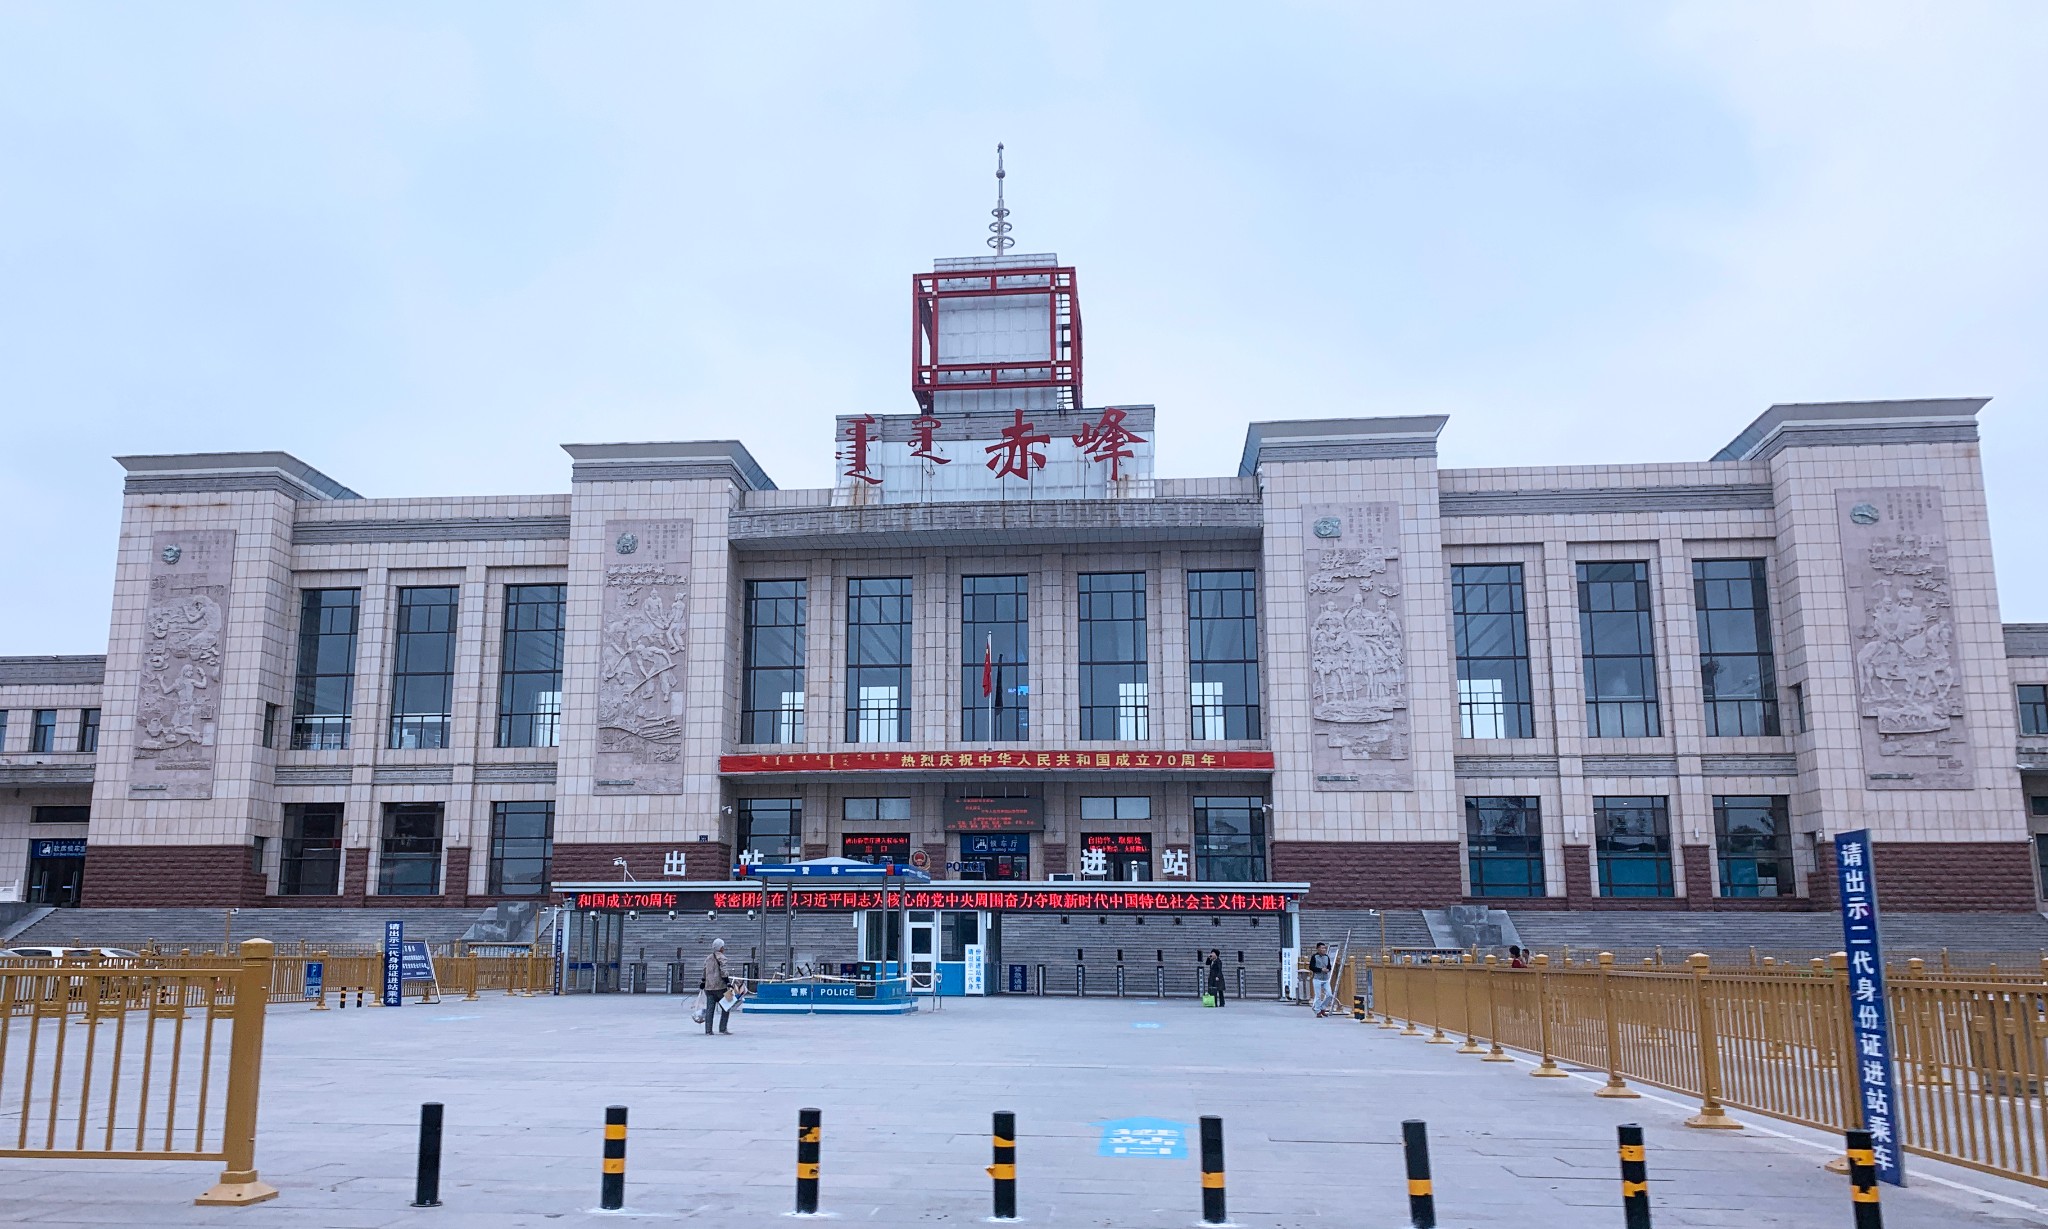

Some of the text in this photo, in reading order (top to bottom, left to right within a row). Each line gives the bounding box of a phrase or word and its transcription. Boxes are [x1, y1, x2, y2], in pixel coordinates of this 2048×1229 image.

[985, 407, 1148, 481] 赤峰
[946, 861, 985, 872] POLICE
[577, 892, 677, 909] 和国成立70周年
[387, 923, 400, 1004] 请出示二代身份证进站乘车
[790, 987, 808, 997] 警察
[820, 988, 855, 996] POLICE
[1841, 842, 1894, 1172] 请出示二代身份证进站乘车
